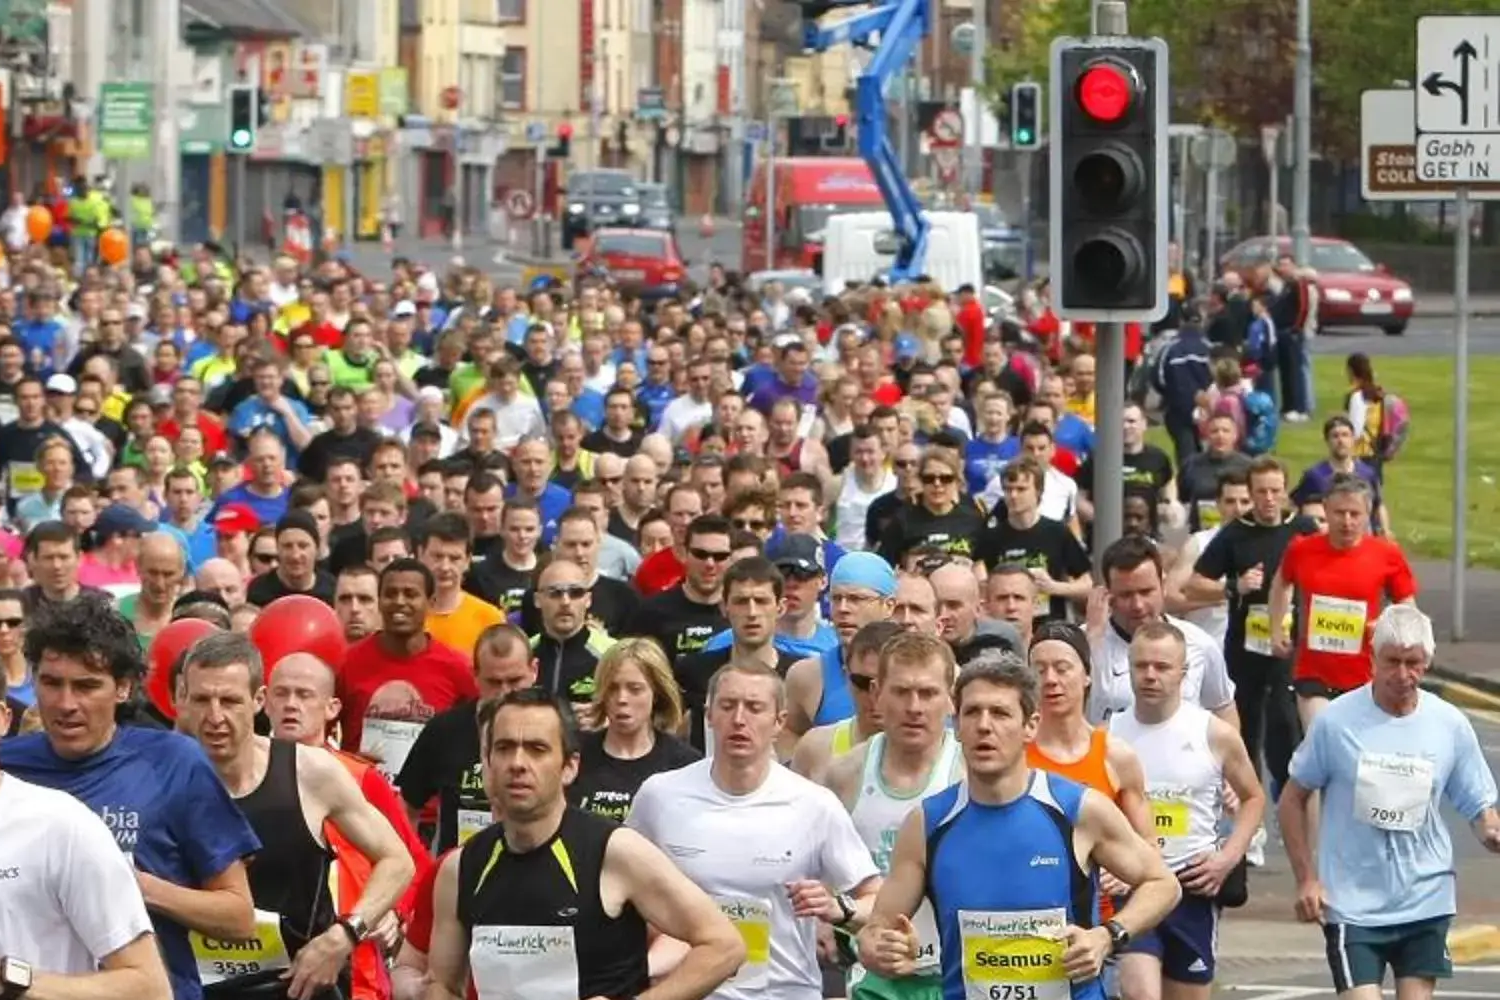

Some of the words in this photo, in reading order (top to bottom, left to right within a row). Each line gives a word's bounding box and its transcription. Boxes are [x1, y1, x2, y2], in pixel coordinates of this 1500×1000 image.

[1425, 139, 1475, 156] Gabh
[1423, 161, 1459, 178] GET
[1469, 161, 1490, 178] IN
[1316, 618, 1355, 632] Kevin
[102, 805, 141, 829] bia
[975, 951, 1053, 967] Seamus
[989, 986, 1037, 1000] 6751
